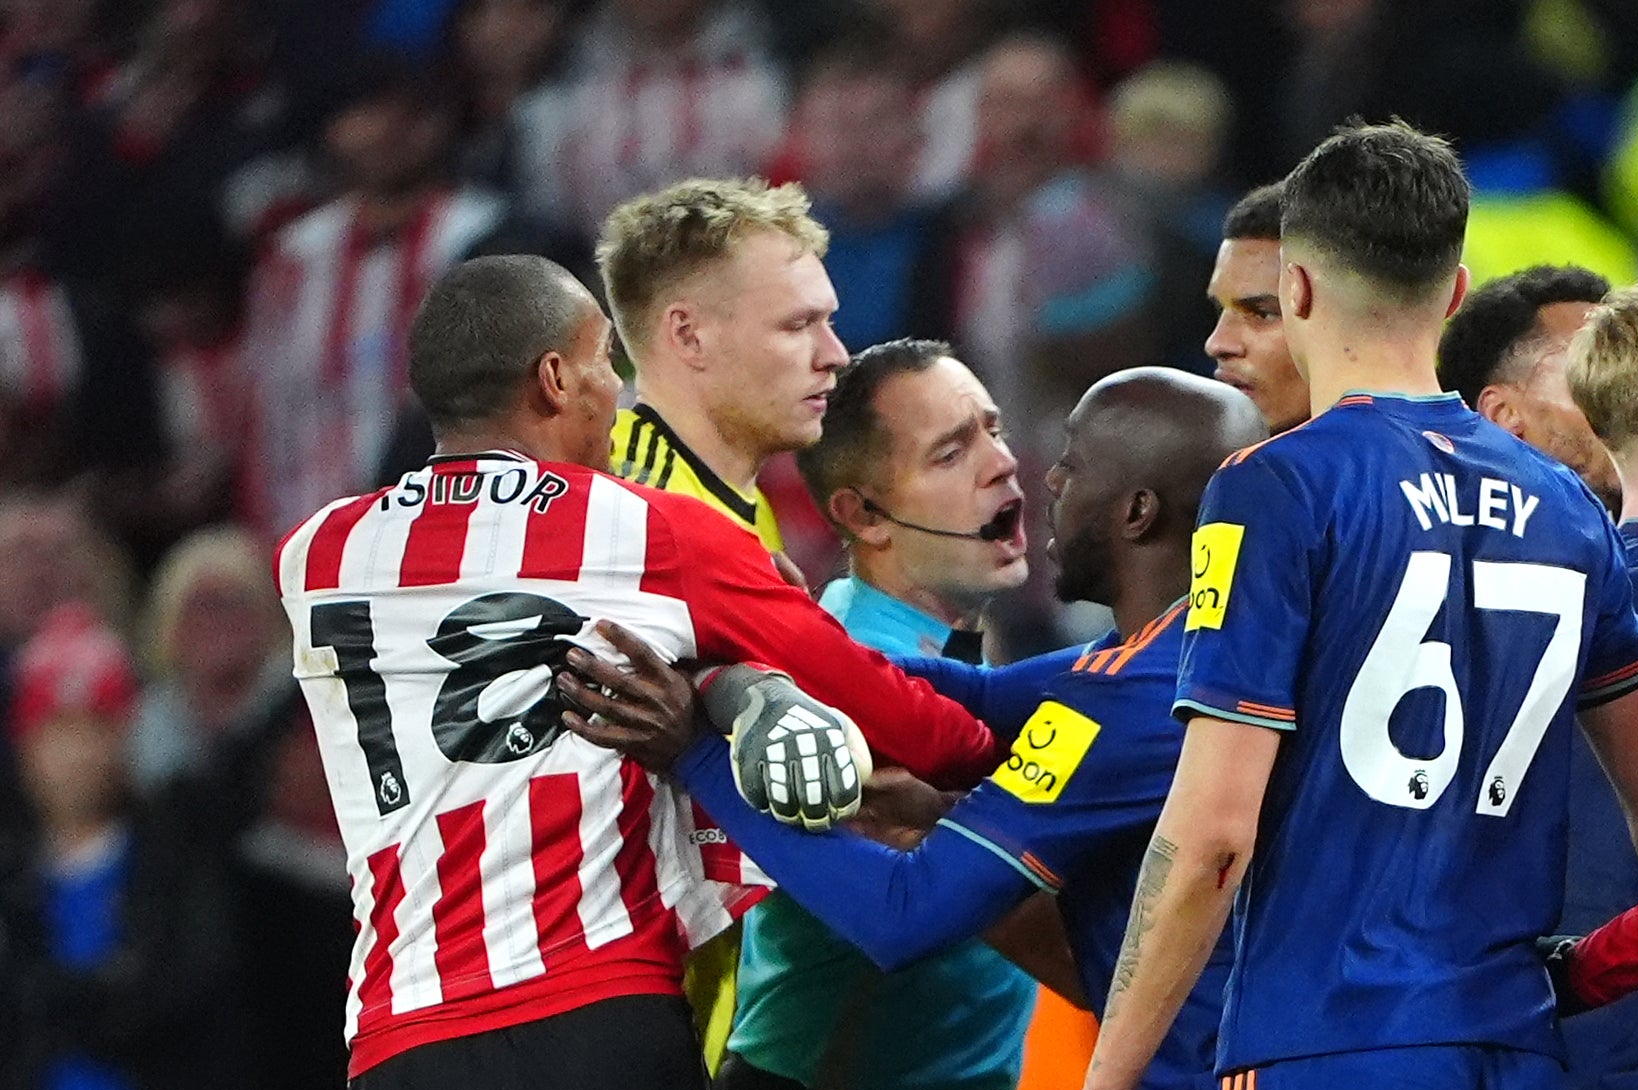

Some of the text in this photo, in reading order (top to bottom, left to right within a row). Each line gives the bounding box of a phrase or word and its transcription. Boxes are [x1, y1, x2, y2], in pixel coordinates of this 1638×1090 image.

[380, 468, 567, 513] ISIDOR
[310, 591, 592, 816] 18
[1340, 550, 1588, 818] 67
